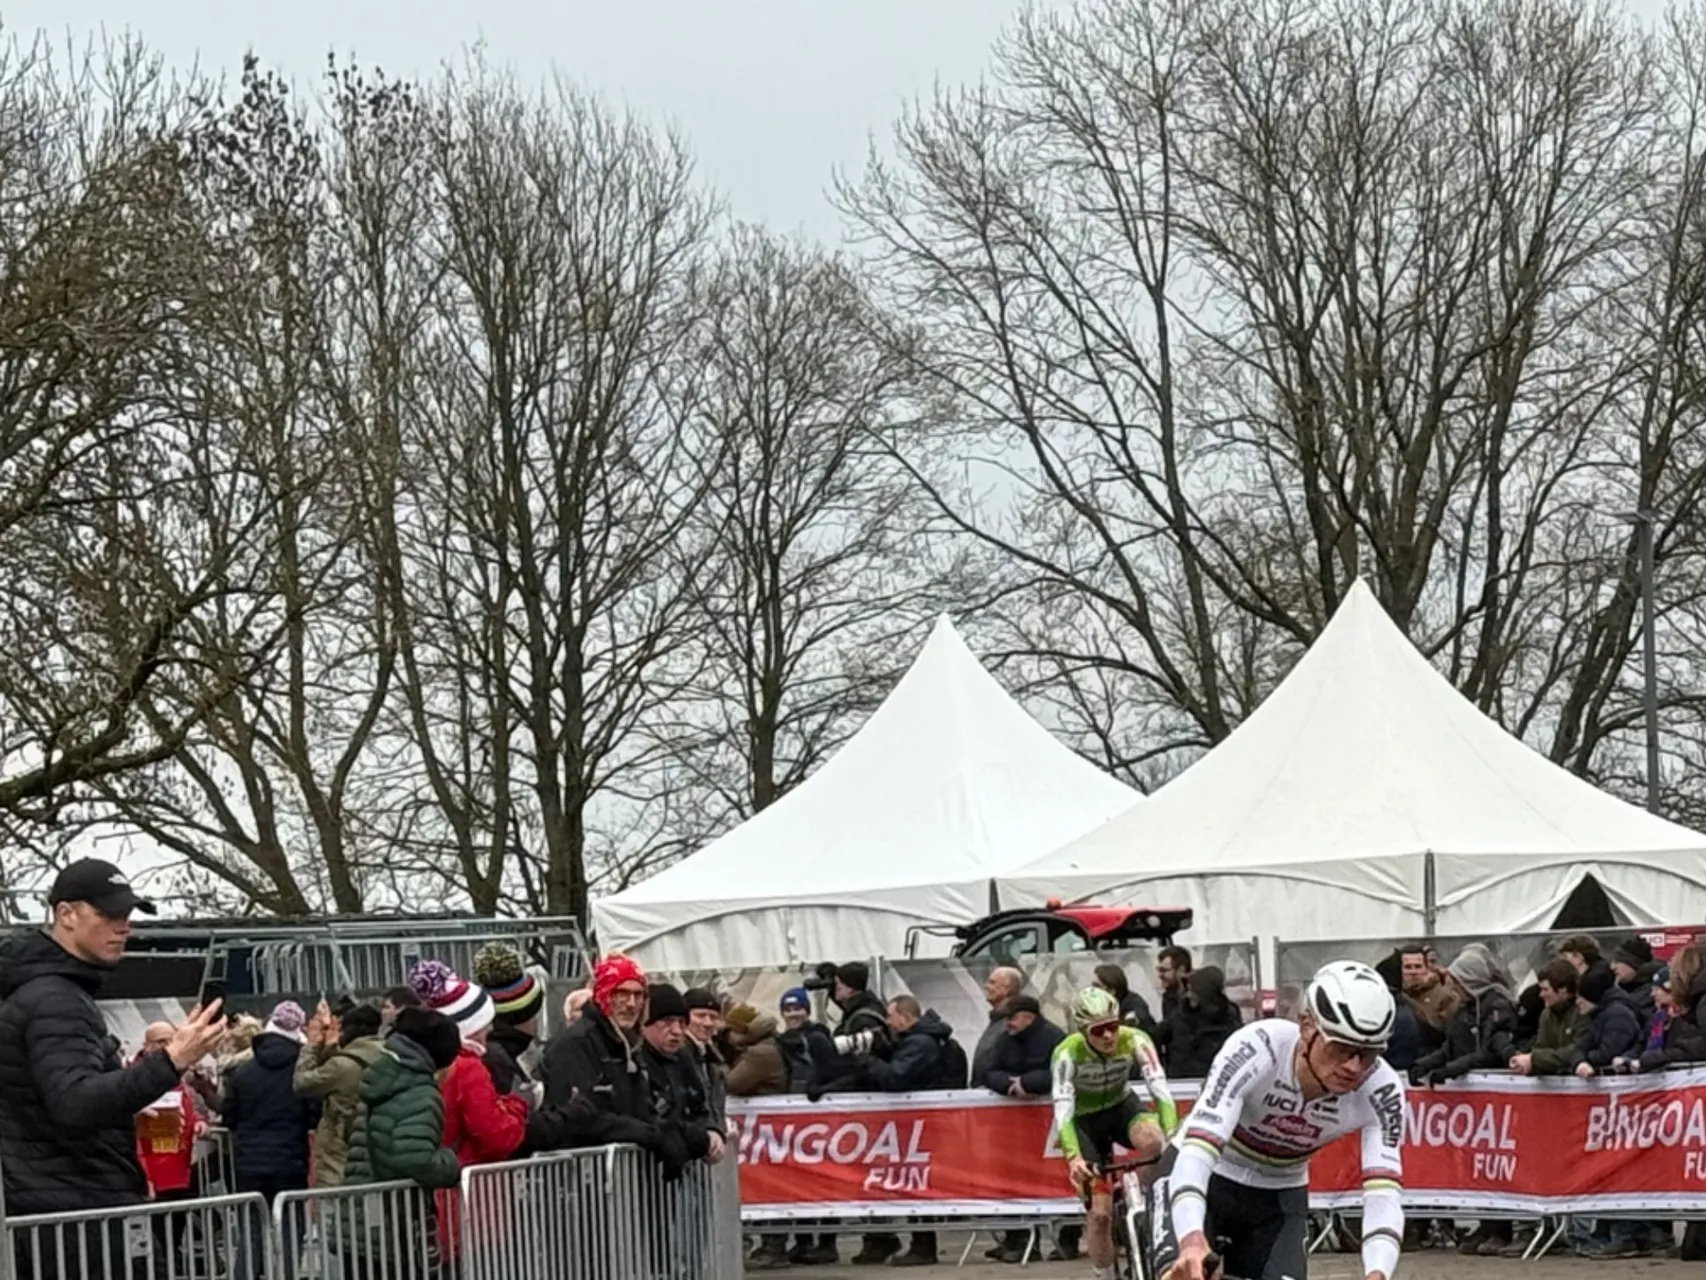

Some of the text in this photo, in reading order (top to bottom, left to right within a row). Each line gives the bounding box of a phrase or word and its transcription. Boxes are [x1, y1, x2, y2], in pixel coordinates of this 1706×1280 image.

[737, 1114, 931, 1165] INGOAL
[1400, 1101, 1517, 1149] NGOAL
[862, 1166, 930, 1191] FUN
[1472, 1152, 1517, 1181] FUN
